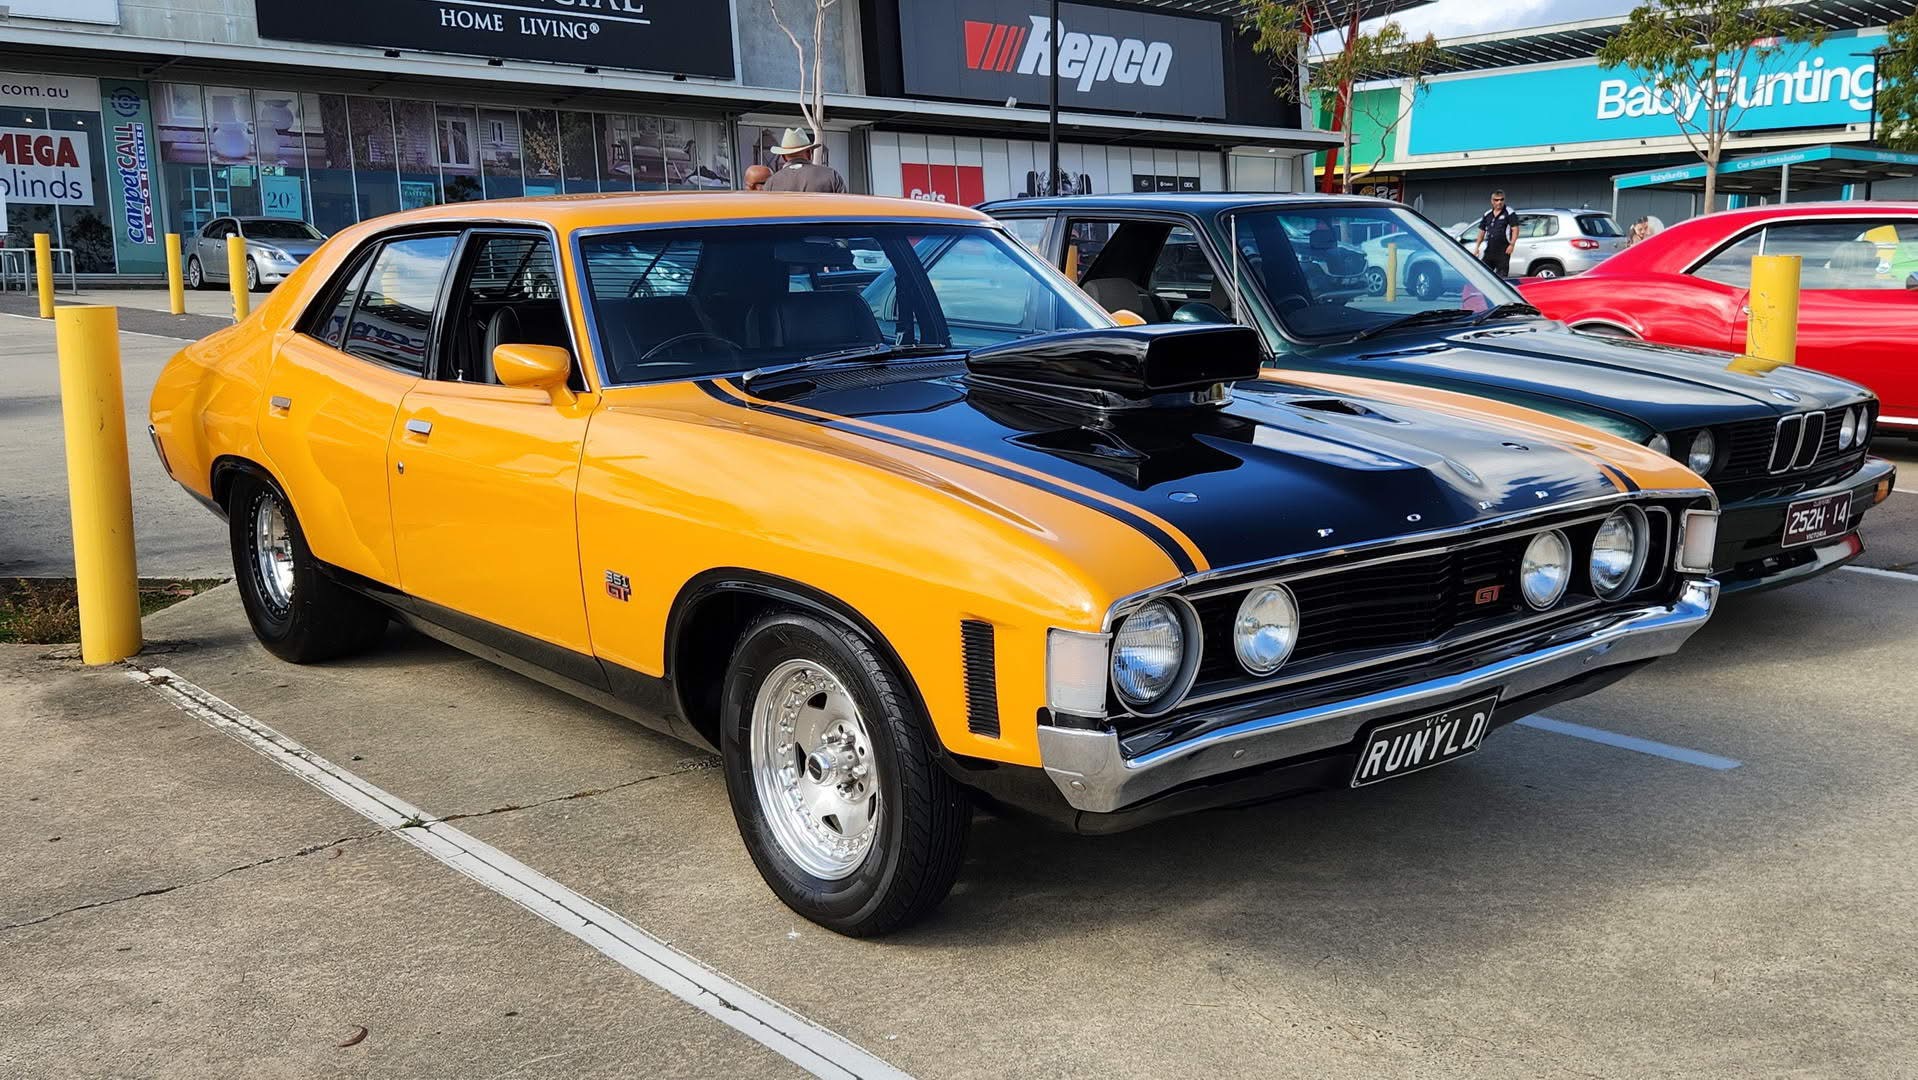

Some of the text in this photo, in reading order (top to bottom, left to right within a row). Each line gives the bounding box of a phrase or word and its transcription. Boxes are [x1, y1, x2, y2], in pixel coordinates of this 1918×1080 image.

[439, 8, 504, 32] HOME
[1017, 15, 1173, 92] Repco
[135, 123, 148, 170] CENTRE
[910, 188, 946, 203] Gets
[605, 582, 631, 601] GT
[1475, 585, 1504, 605] GT
[1426, 714, 1448, 727] VIC
[1361, 712, 1485, 779] RUNYLD
